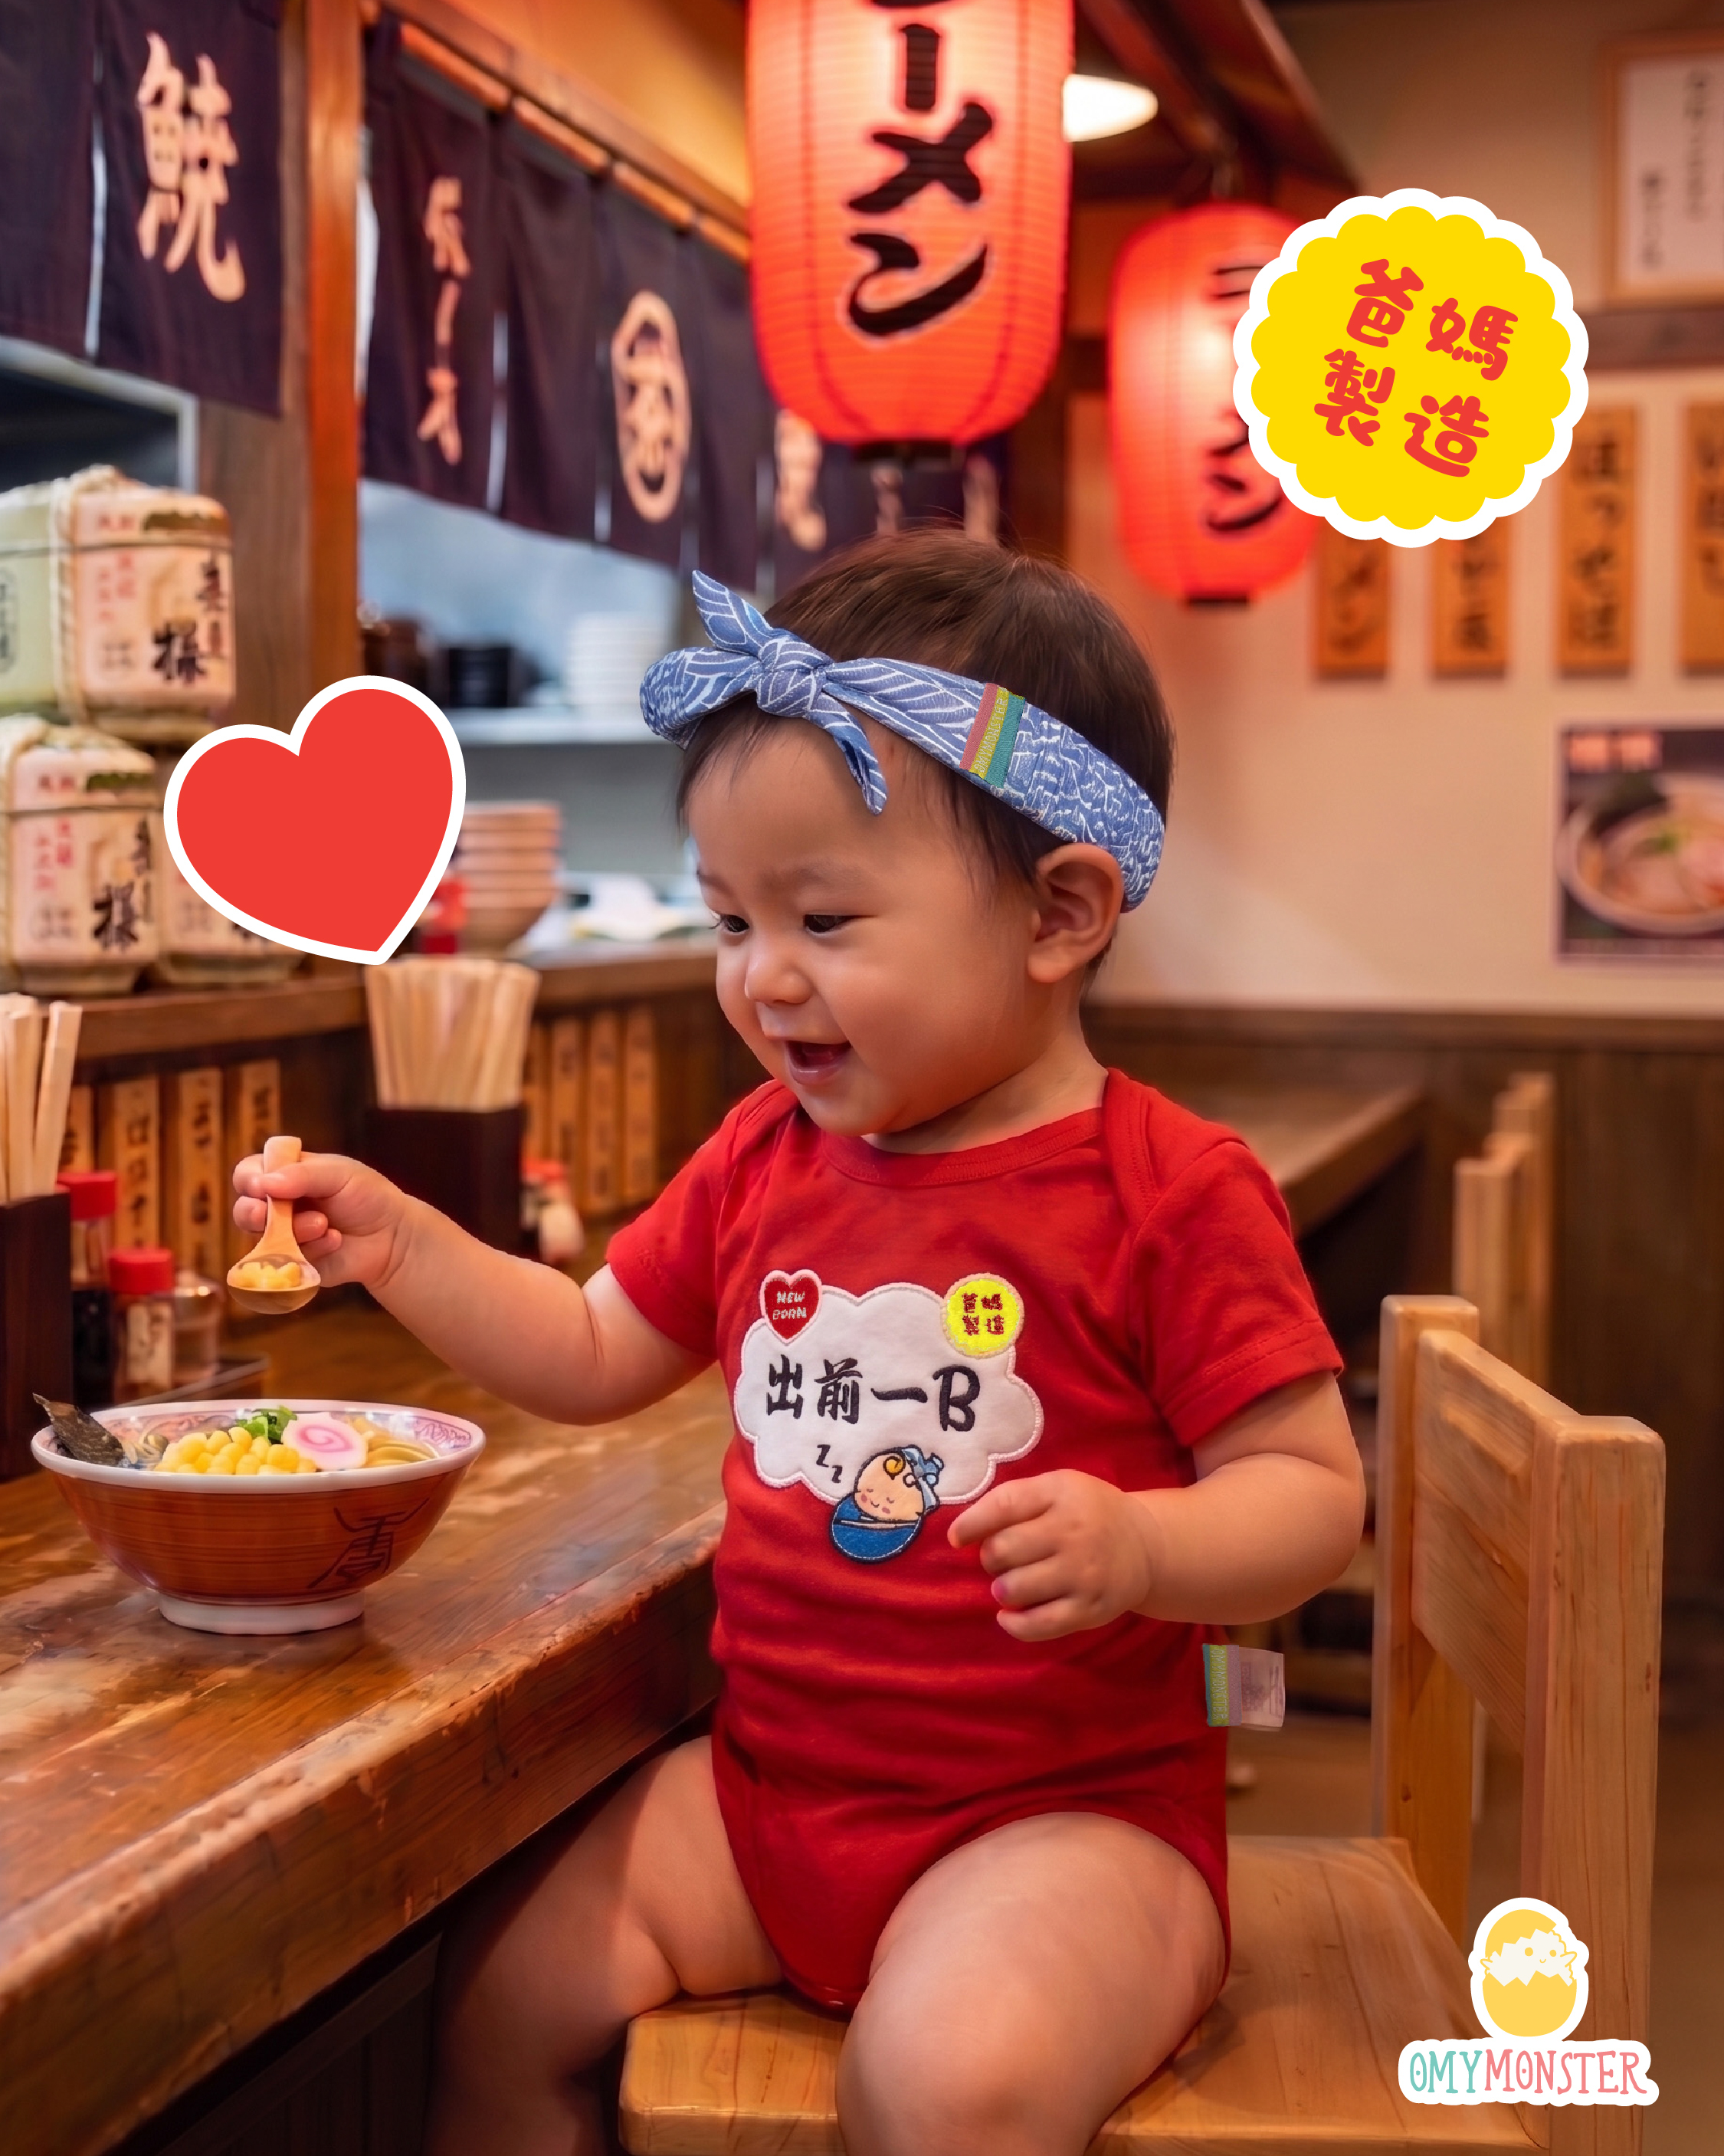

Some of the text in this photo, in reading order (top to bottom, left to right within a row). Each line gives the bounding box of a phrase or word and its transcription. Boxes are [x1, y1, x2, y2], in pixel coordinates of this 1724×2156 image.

[848, 0, 993, 336] ーメン
[974, 697, 1008, 773] OMYMONSTER
[772, 1306, 808, 1321] BORN
[776, 1291, 806, 1304] NEW
[766, 1354, 981, 1432] 出前一B
[1211, 1648, 1228, 1720] OMYMONSTER
